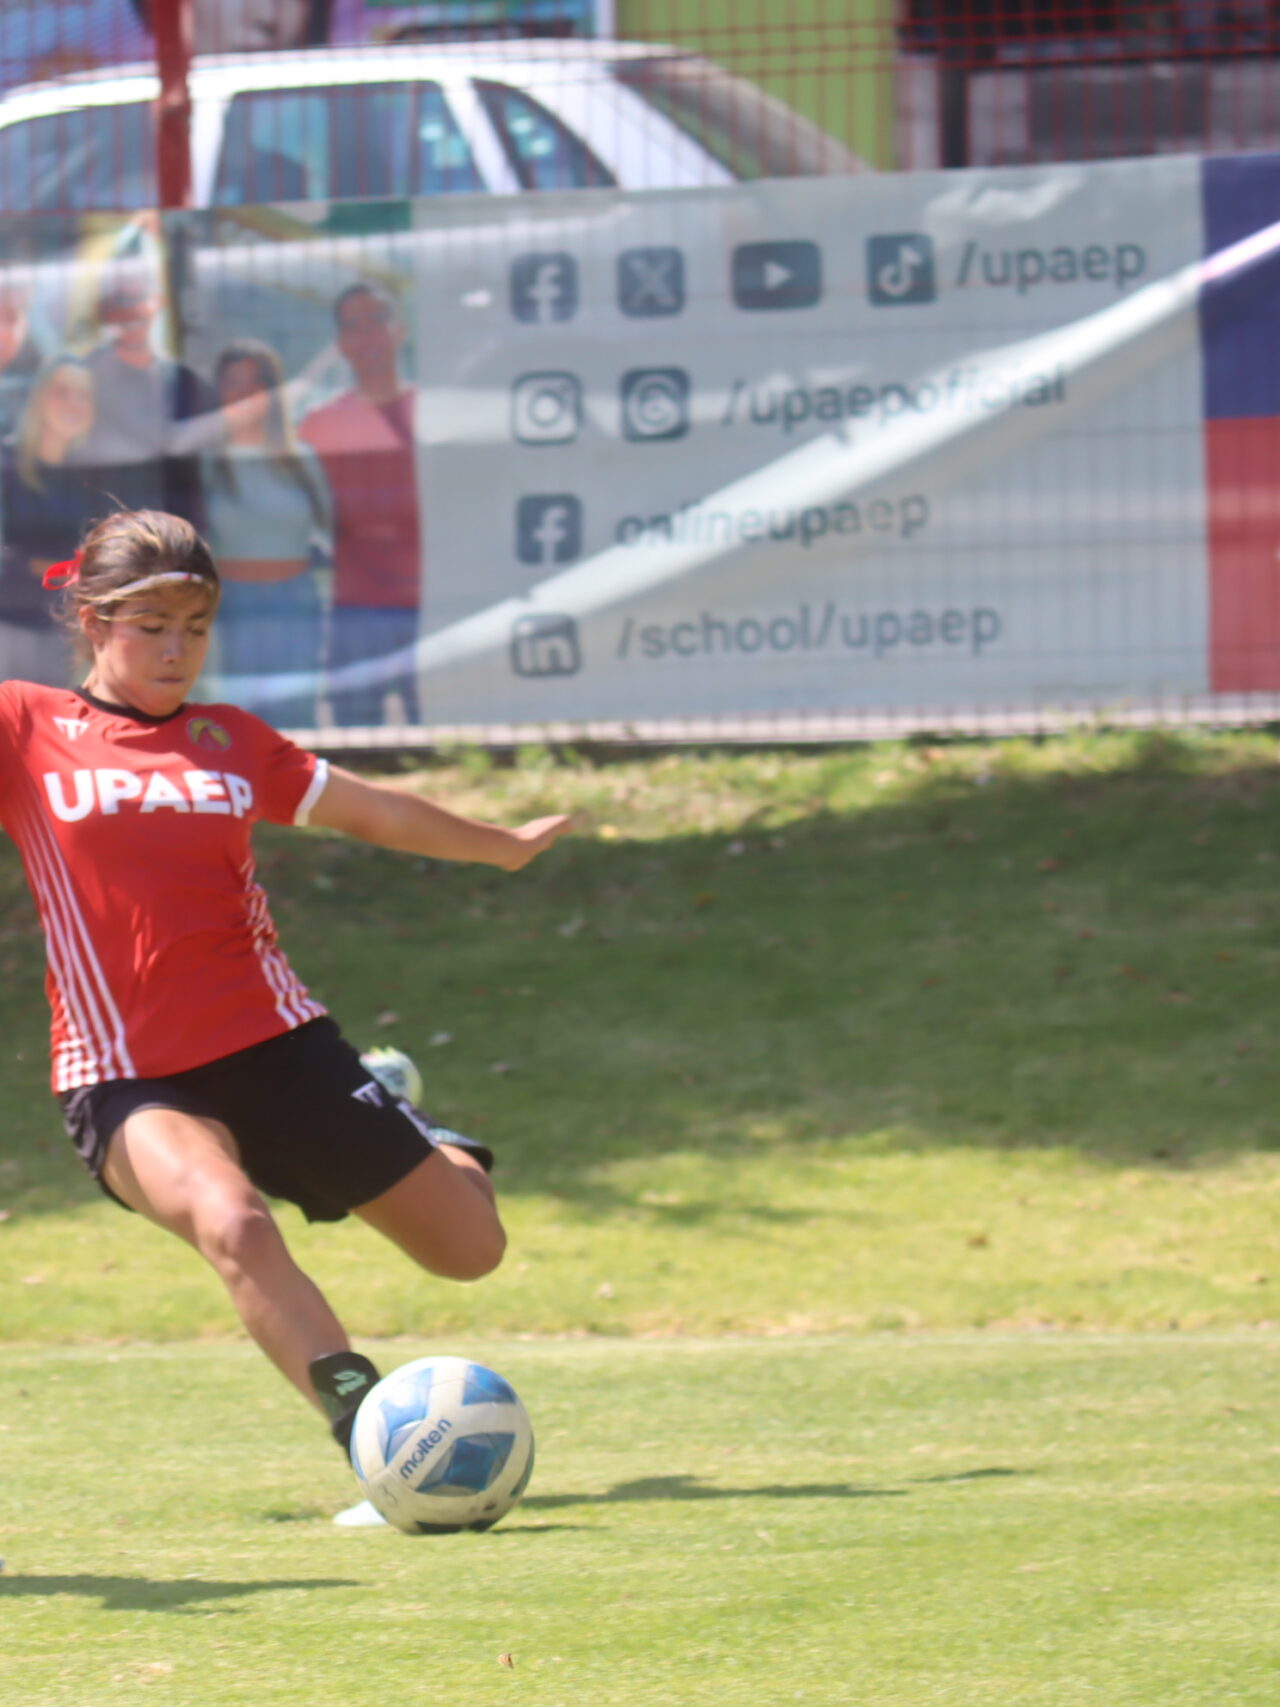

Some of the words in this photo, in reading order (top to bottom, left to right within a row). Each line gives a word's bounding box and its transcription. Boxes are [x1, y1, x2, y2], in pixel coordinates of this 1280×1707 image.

[956, 240, 1146, 290] /upaep
[618, 604, 1001, 657] /school/upaep
[43, 767, 253, 822] UPAEP
[400, 1417, 453, 1480] molten
